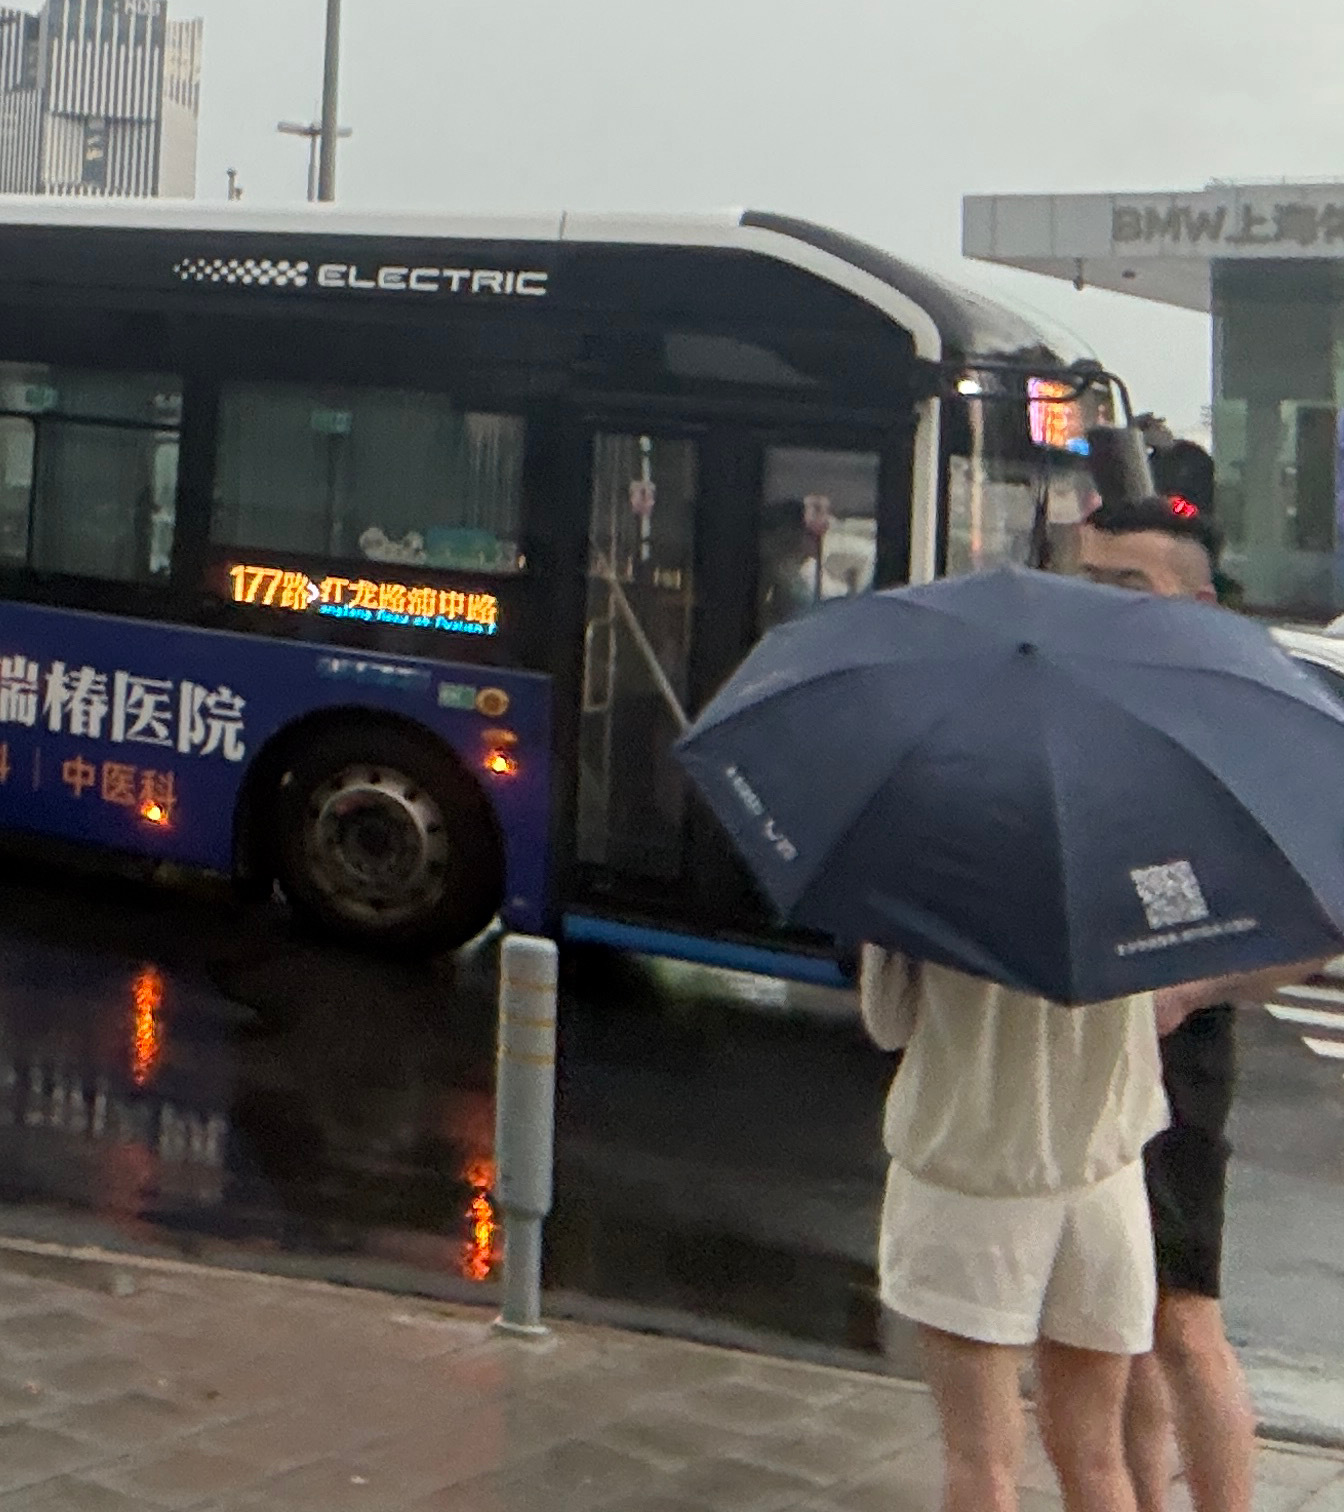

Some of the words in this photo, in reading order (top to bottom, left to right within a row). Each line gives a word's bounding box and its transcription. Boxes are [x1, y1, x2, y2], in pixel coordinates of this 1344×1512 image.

[317, 263, 549, 295] ELECTRIC
[230, 564, 310, 610] 177路
[61, 755, 178, 814] 中医科
